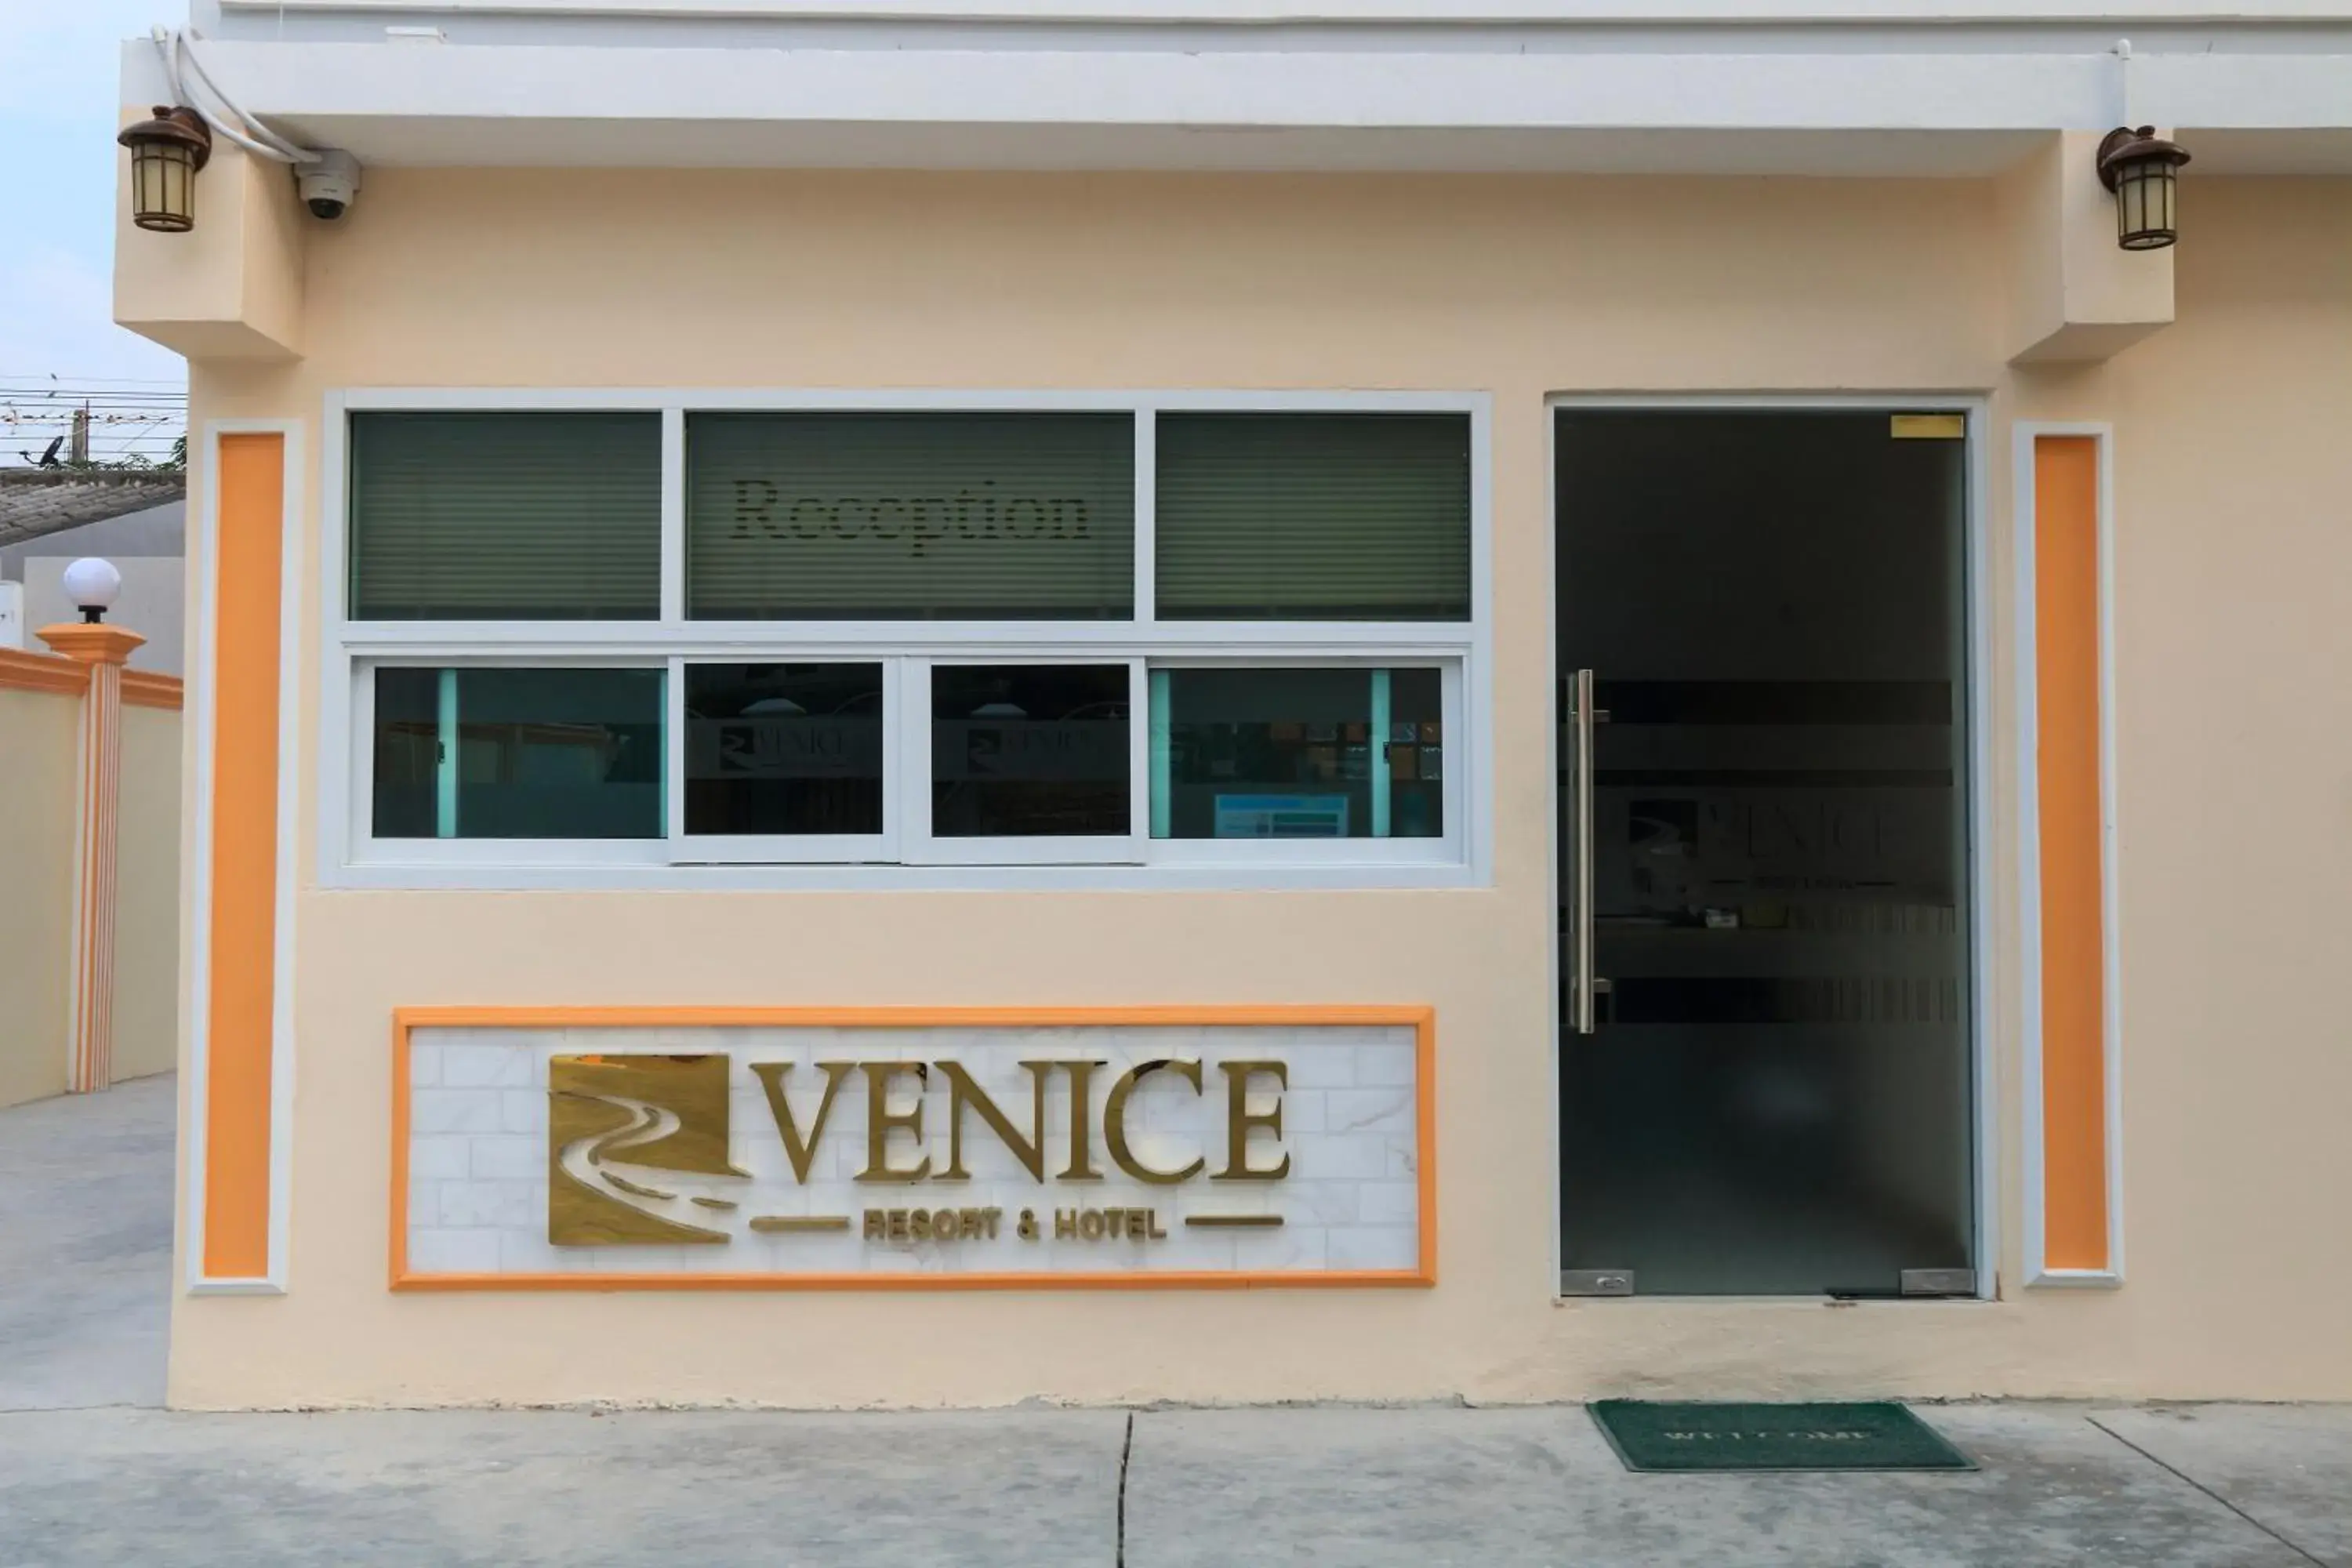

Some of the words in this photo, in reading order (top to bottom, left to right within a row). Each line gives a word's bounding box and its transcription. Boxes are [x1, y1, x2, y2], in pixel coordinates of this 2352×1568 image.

[730, 479, 1091, 557] Reception
[748, 1058, 1290, 1185] VENICE
[863, 1207, 1003, 1241] RESORT
[1018, 1207, 1040, 1241] &
[1054, 1207, 1167, 1241] HOTEL
